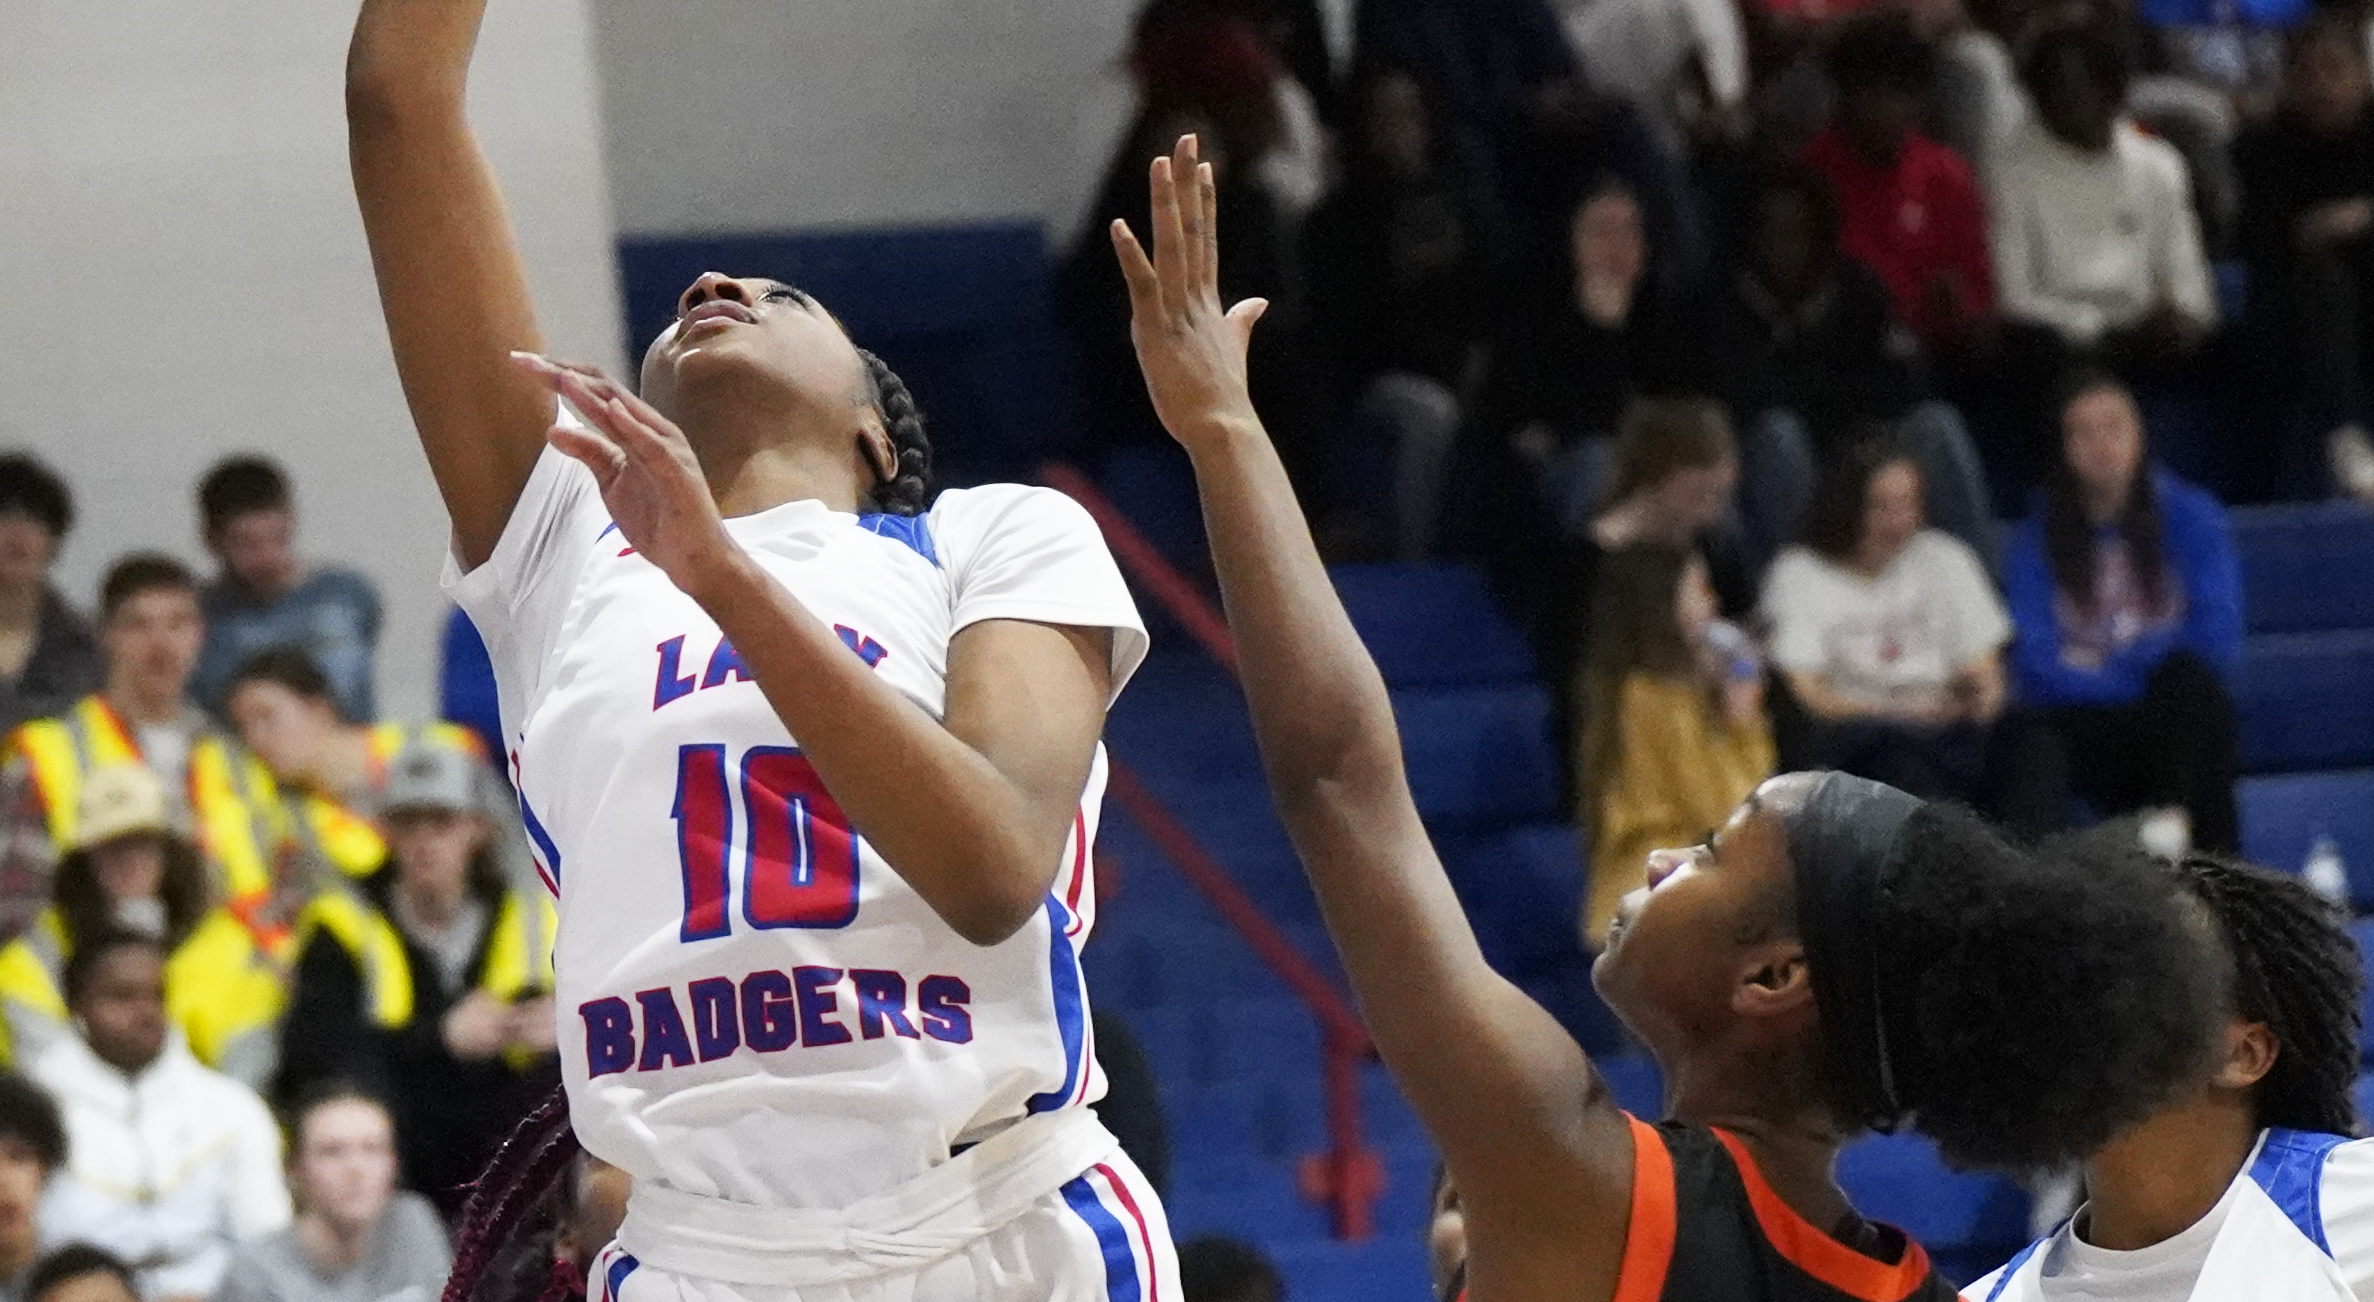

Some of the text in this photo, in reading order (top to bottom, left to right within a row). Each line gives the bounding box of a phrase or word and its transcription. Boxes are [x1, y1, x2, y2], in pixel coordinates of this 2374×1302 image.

[653, 623, 888, 712] LAY
[670, 743, 861, 943] 10
[579, 965, 973, 1080] BADGERS
